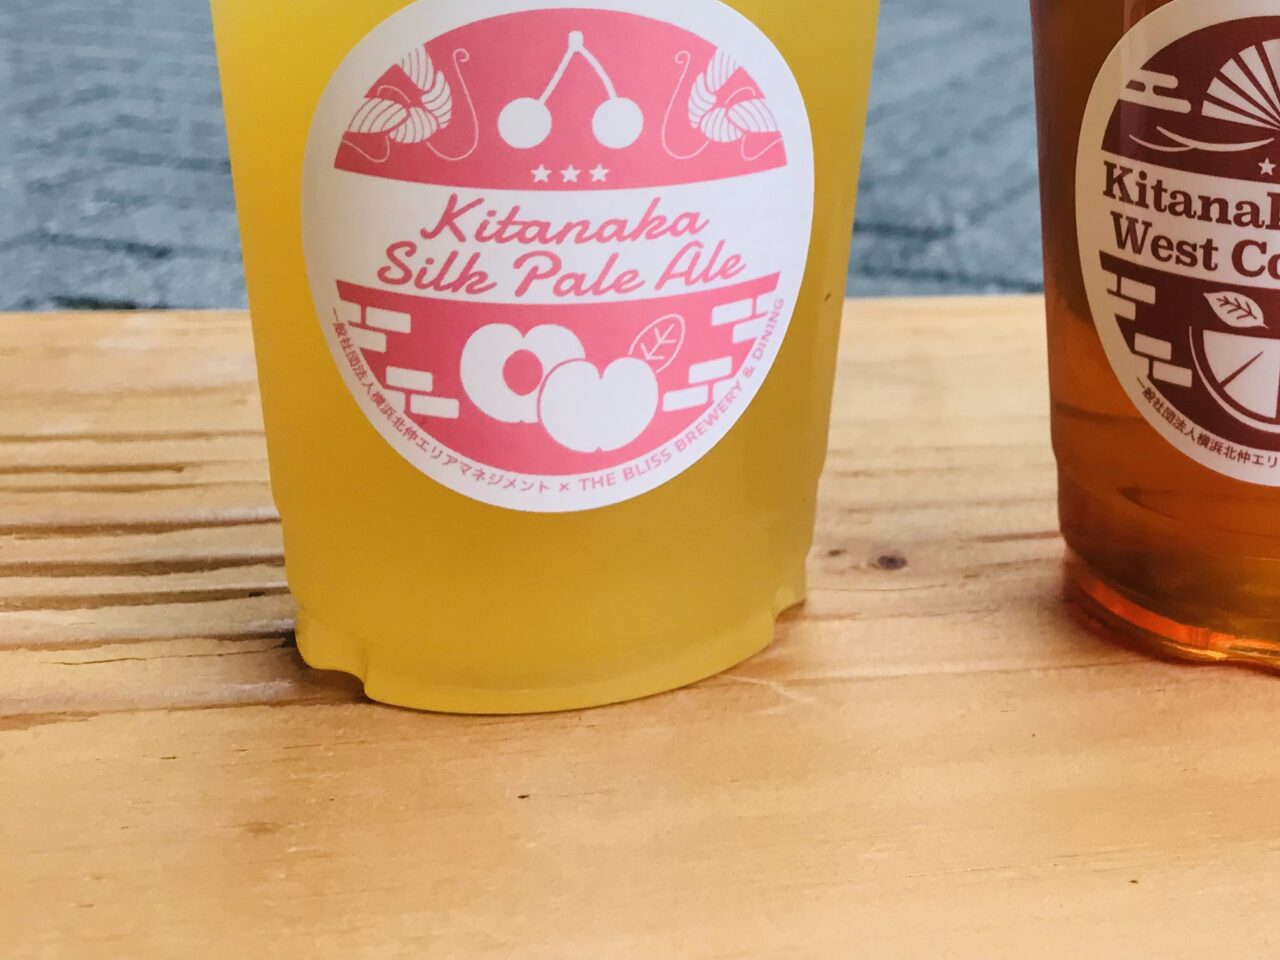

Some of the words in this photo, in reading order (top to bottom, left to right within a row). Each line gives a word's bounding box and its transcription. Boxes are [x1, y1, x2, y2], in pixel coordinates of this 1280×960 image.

[420, 193, 710, 244] Kitanaka
[1110, 210, 1219, 272] West
[377, 241, 497, 296] Silk
[513, 250, 645, 298] Pale
[653, 240, 747, 291] Ale
[578, 472, 617, 491] THE
[623, 448, 673, 481] BLISS
[674, 380, 744, 453] BREWERY
[742, 366, 756, 378] &
[752, 297, 785, 361] DINING
